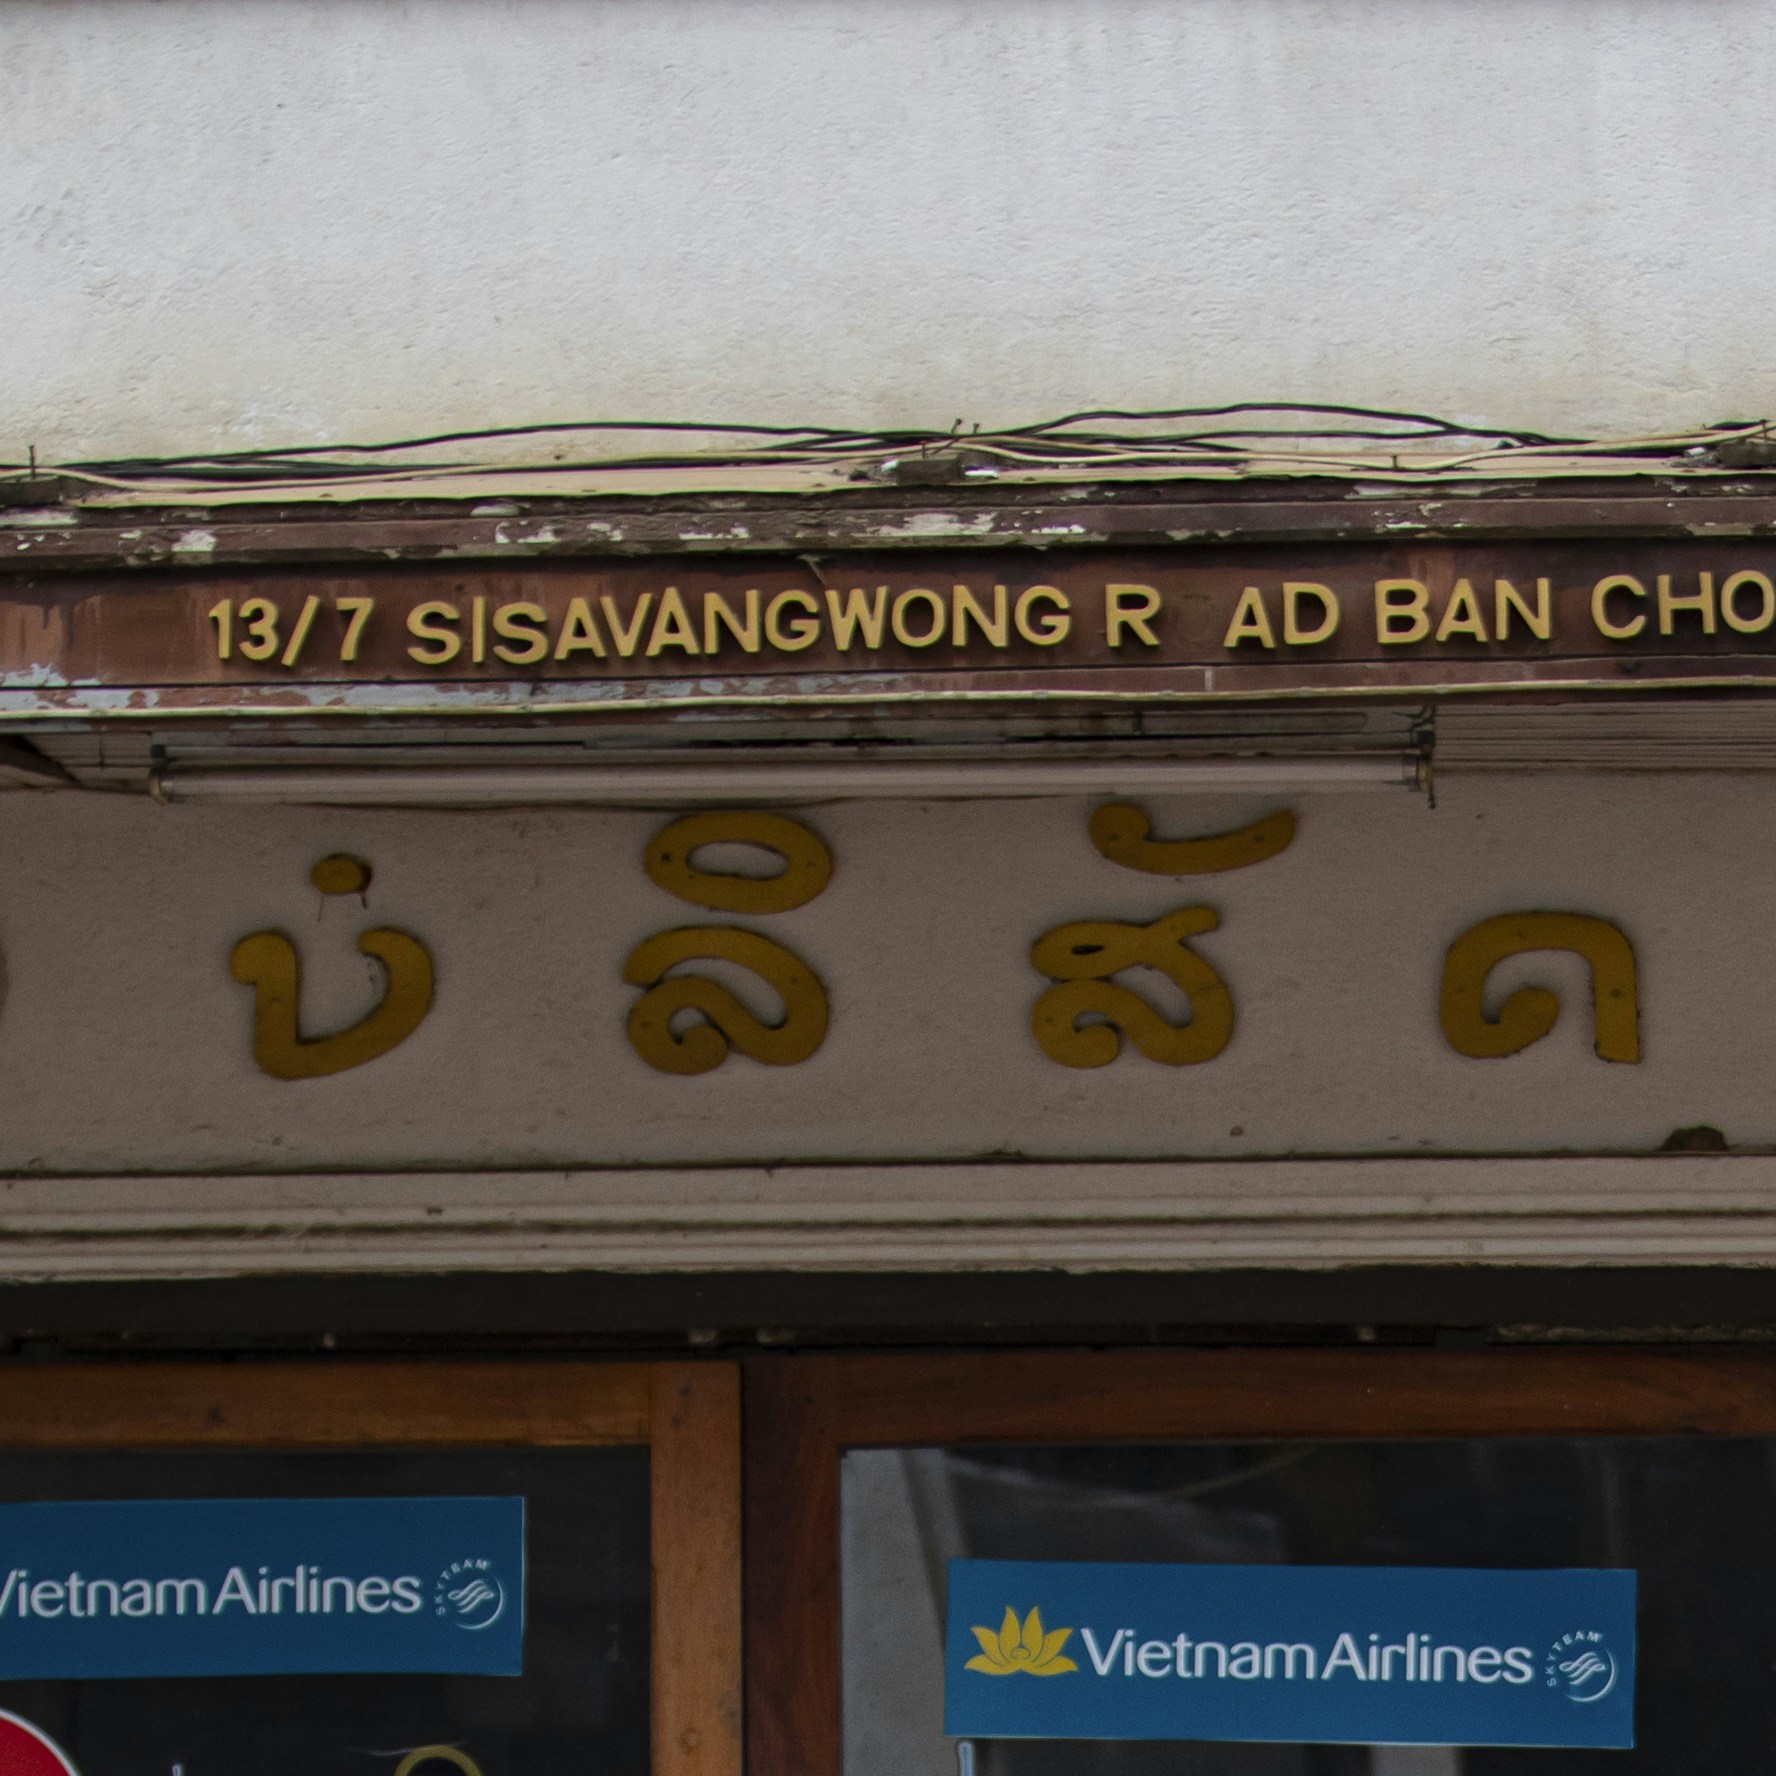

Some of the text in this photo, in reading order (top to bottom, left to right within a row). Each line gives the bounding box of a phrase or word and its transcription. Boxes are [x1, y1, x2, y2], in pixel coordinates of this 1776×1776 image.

[208, 596, 374, 667] 13/7
[408, 584, 1071, 665] SISAVANGWONG
[1375, 578, 1551, 645] BAN
[212, 1565, 423, 1614] Airlines
[1080, 1627, 1602, 1687] Vietnam Airlines SKYTEAM
